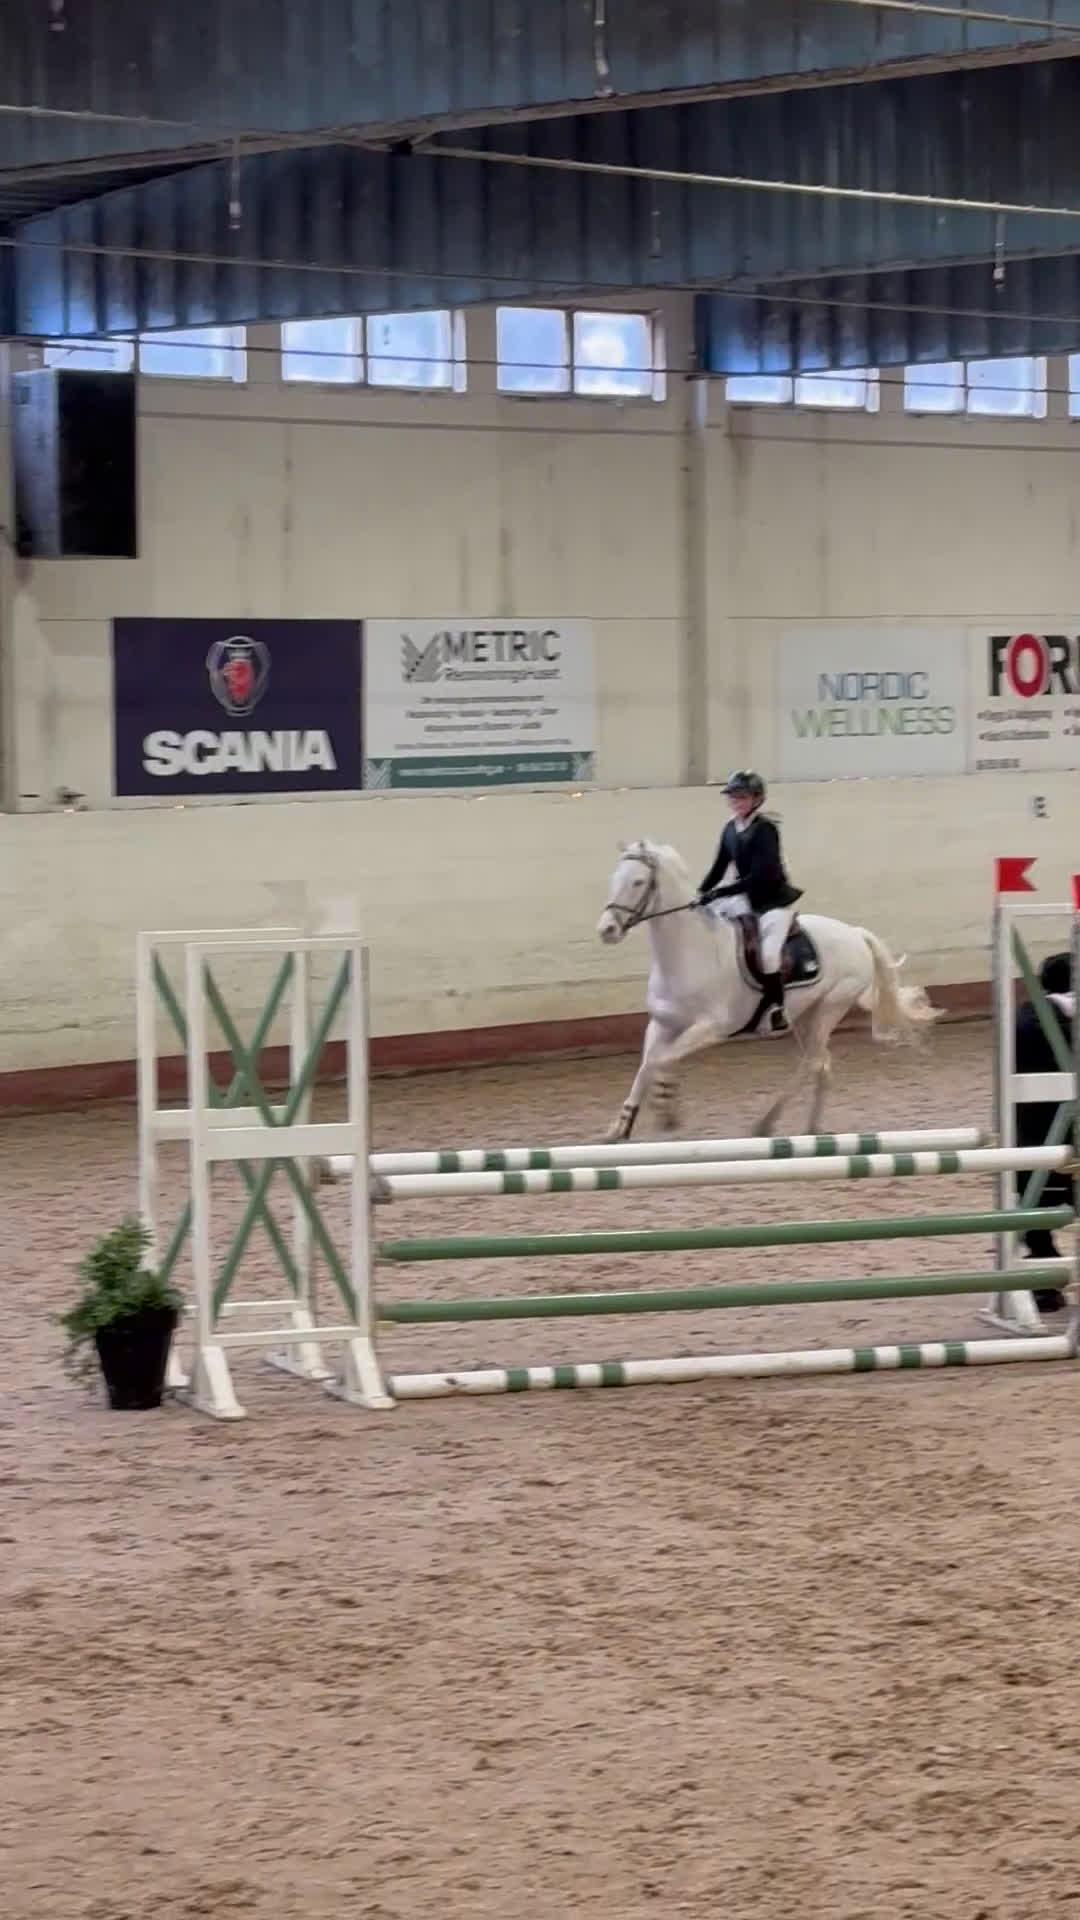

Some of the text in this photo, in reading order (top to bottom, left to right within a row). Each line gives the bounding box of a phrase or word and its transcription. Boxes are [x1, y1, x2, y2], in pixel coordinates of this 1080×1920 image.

[442, 630, 561, 662] METRIC
[988, 633, 1080, 698] FOR
[817, 671, 929, 701] NORDIC
[791, 706, 955, 738] WELLNESS
[142, 730, 337, 776] SCANIA
